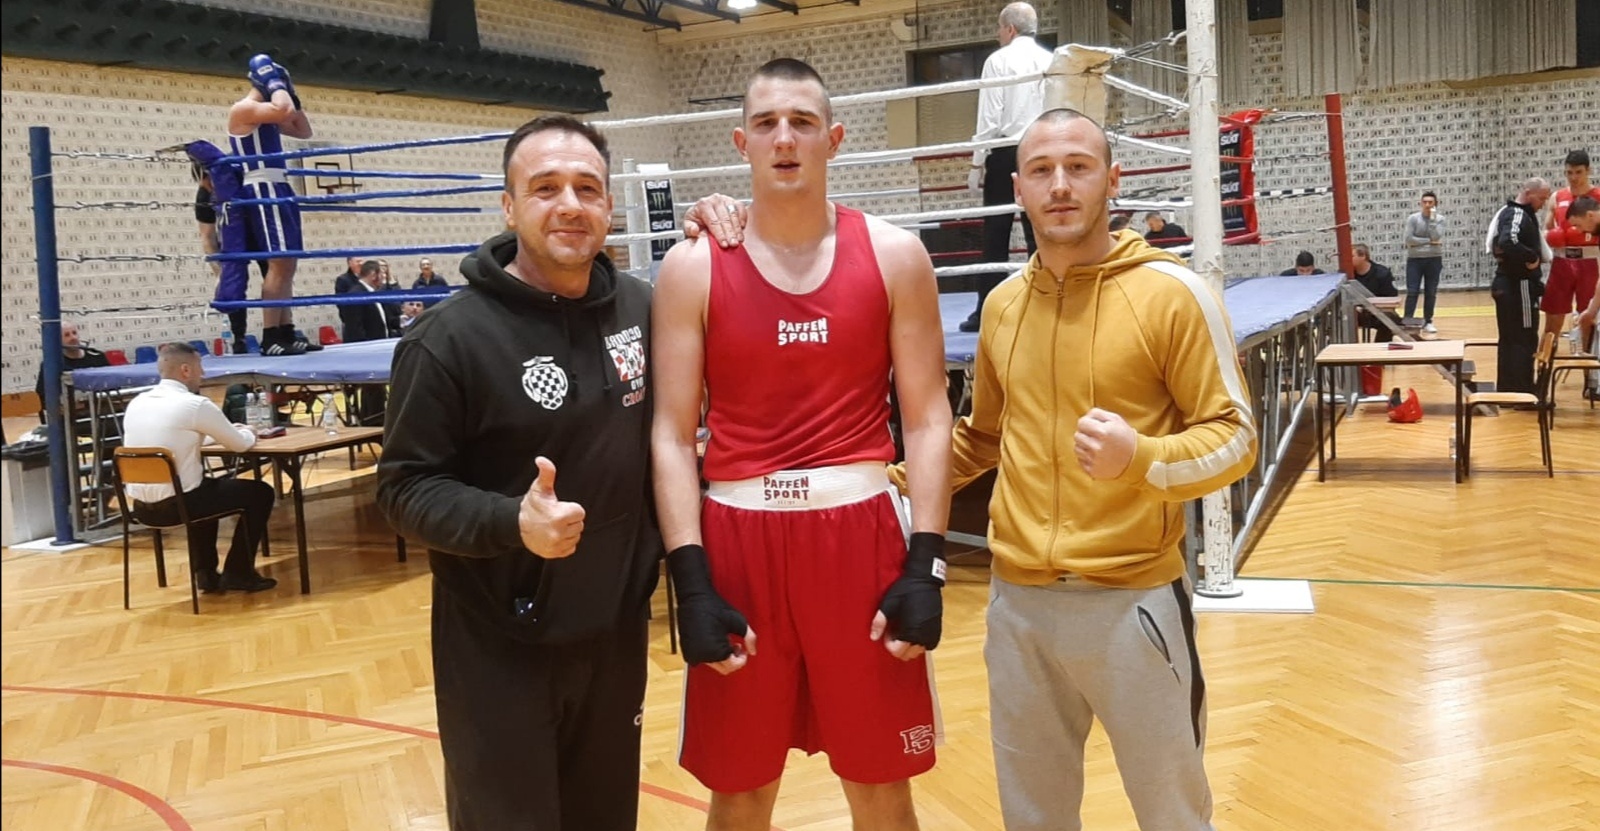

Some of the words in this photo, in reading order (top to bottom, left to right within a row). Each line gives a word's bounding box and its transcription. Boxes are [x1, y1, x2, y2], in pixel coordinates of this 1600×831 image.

[778, 317, 827, 332] PAFFEN
[778, 331, 829, 346] SPORT
[763, 475, 809, 489] PAFFEN
[764, 489, 810, 501] SPORT
